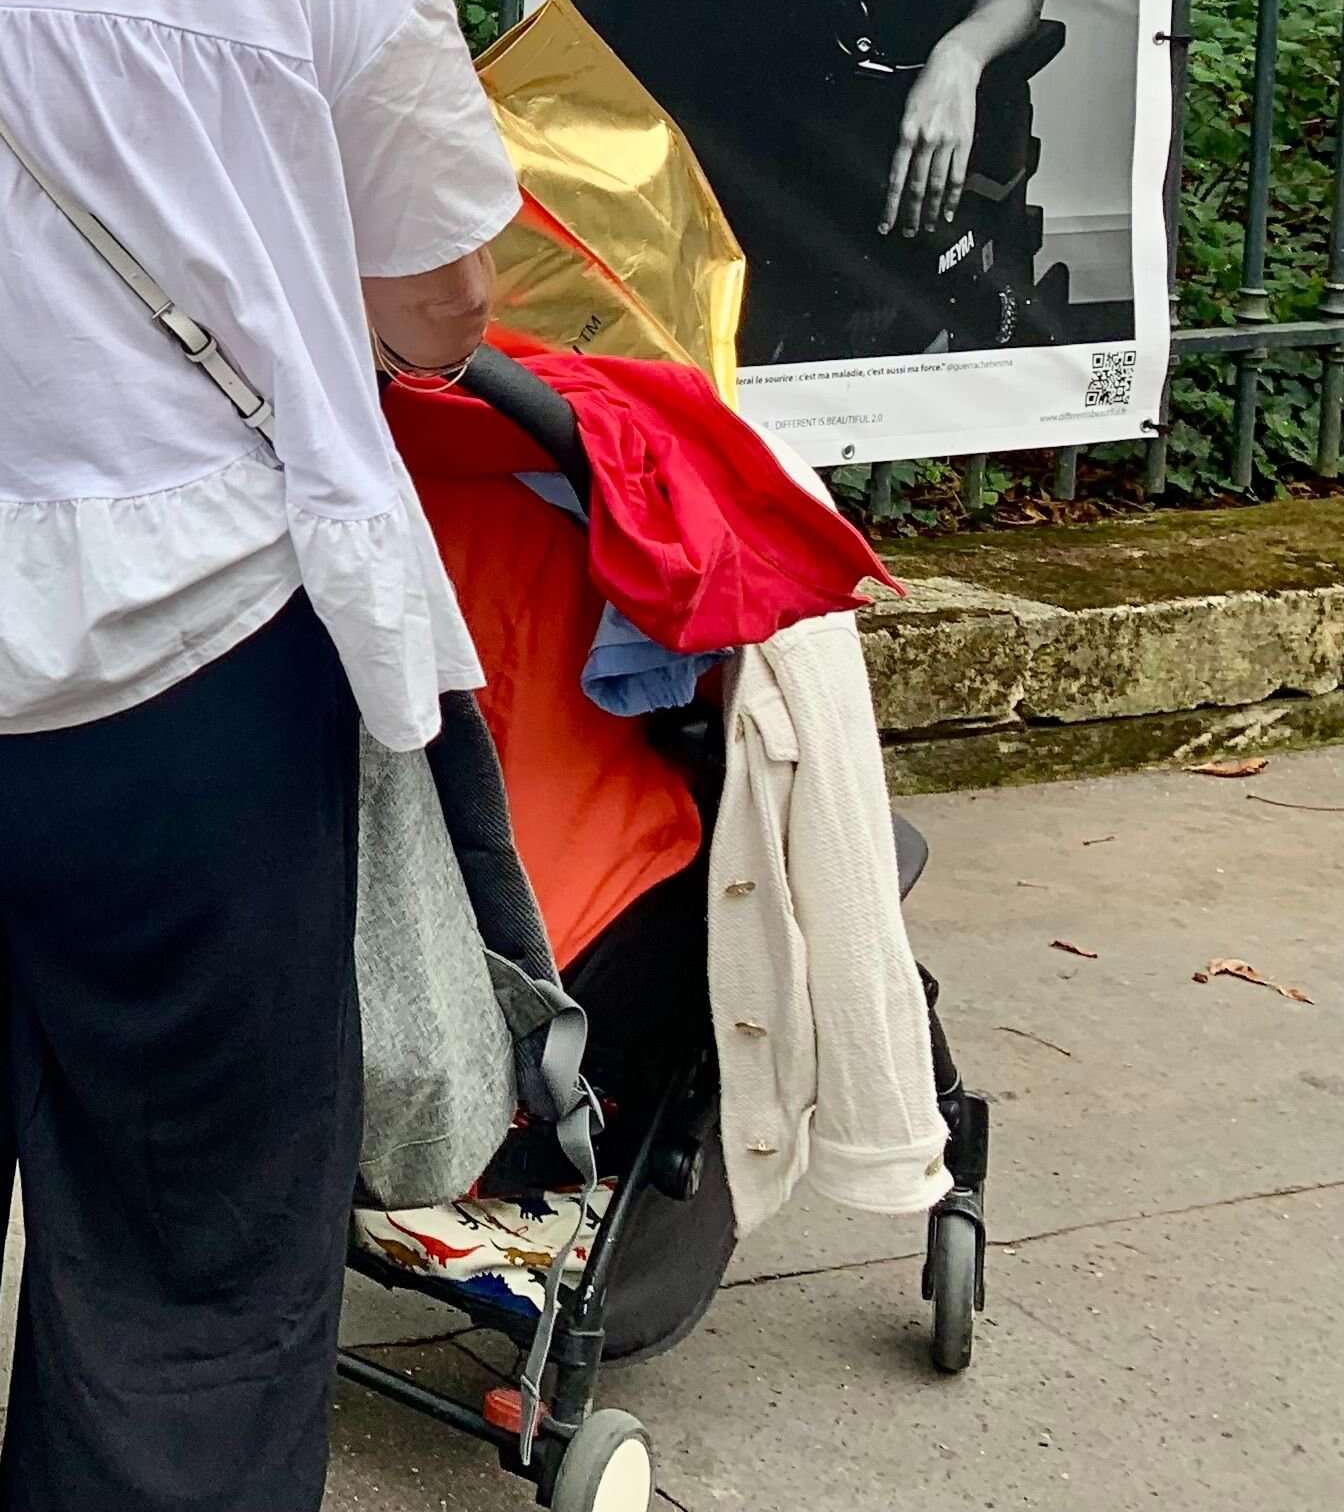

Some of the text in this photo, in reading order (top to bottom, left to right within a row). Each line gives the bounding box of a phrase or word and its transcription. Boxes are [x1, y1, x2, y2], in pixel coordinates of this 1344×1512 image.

[938, 230, 975, 275] MEYRA
[578, 314, 603, 342] TM
[755, 375, 763, 384] le
[764, 374, 793, 384] sourire
[799, 373, 816, 382] c'est
[818, 372, 830, 380] ma
[867, 367, 884, 377] c'est
[886, 365, 905, 375] aussi
[775, 417, 817, 430] DIFFERENT
[818, 417, 825, 426] IS
[826, 415, 870, 425] BEAUTIFUL
